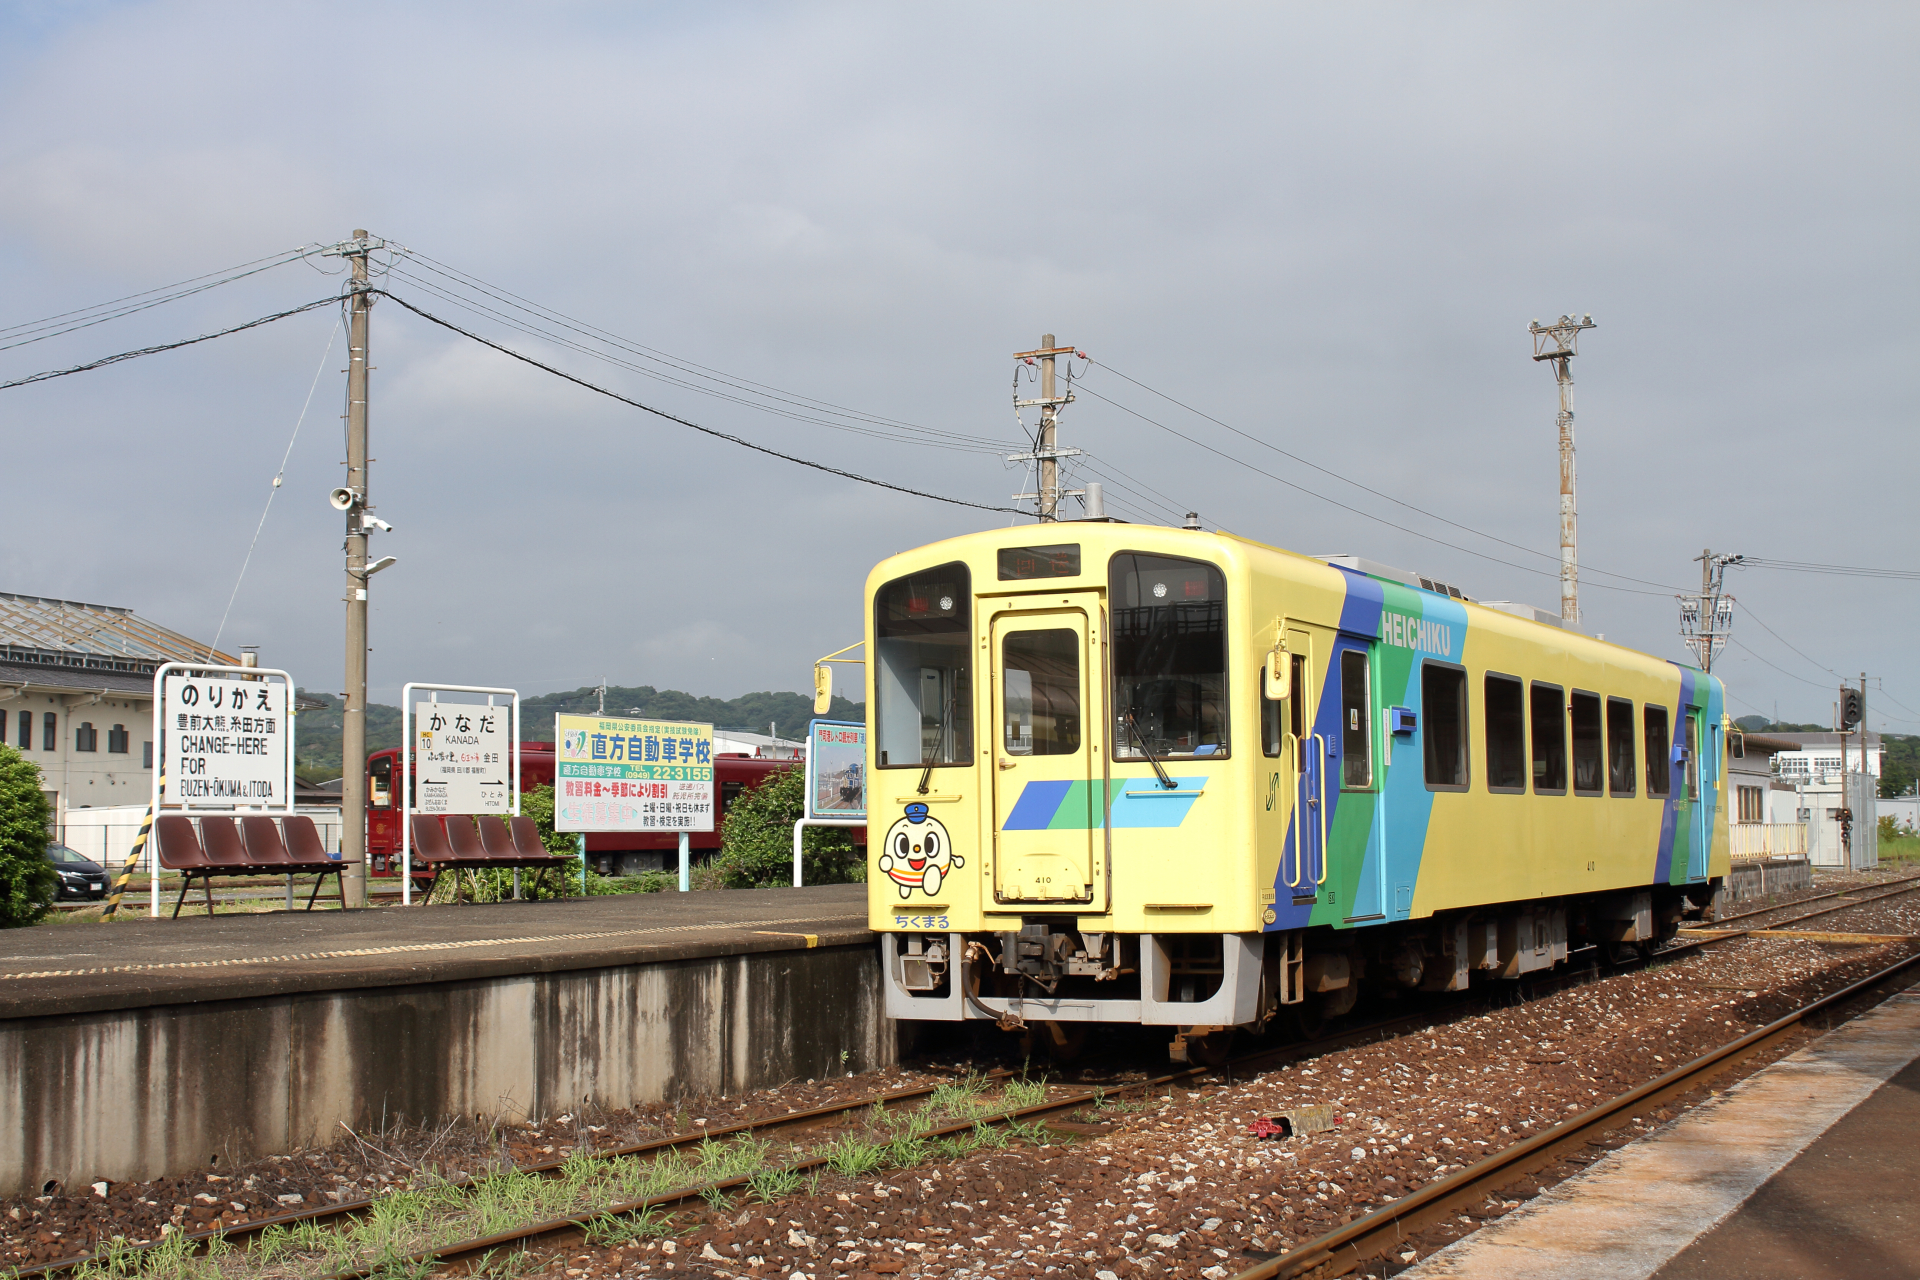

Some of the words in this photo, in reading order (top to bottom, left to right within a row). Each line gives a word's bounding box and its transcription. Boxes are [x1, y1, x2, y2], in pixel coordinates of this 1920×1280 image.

[1382, 610, 1451, 657] HEICHIKU
[181, 684, 272, 711] のりかえ
[430, 713, 495, 734] かなだ
[181, 735, 268, 755] CHANGE-HERE
[421, 738, 431, 749] 10
[445, 735, 480, 745] KANADA
[590, 732, 711, 765] 直方自動車学校
[483, 752, 499, 763] 金田
[180, 757, 206, 775] FOR
[563, 764, 622, 777] 直方自動車学校
[630, 764, 646, 772] TEL
[625, 771, 650, 779] (0949)
[249, 780, 273, 798] ITODA
[1035, 876, 1052, 884] 410
[895, 915, 950, 929] ちくまる
